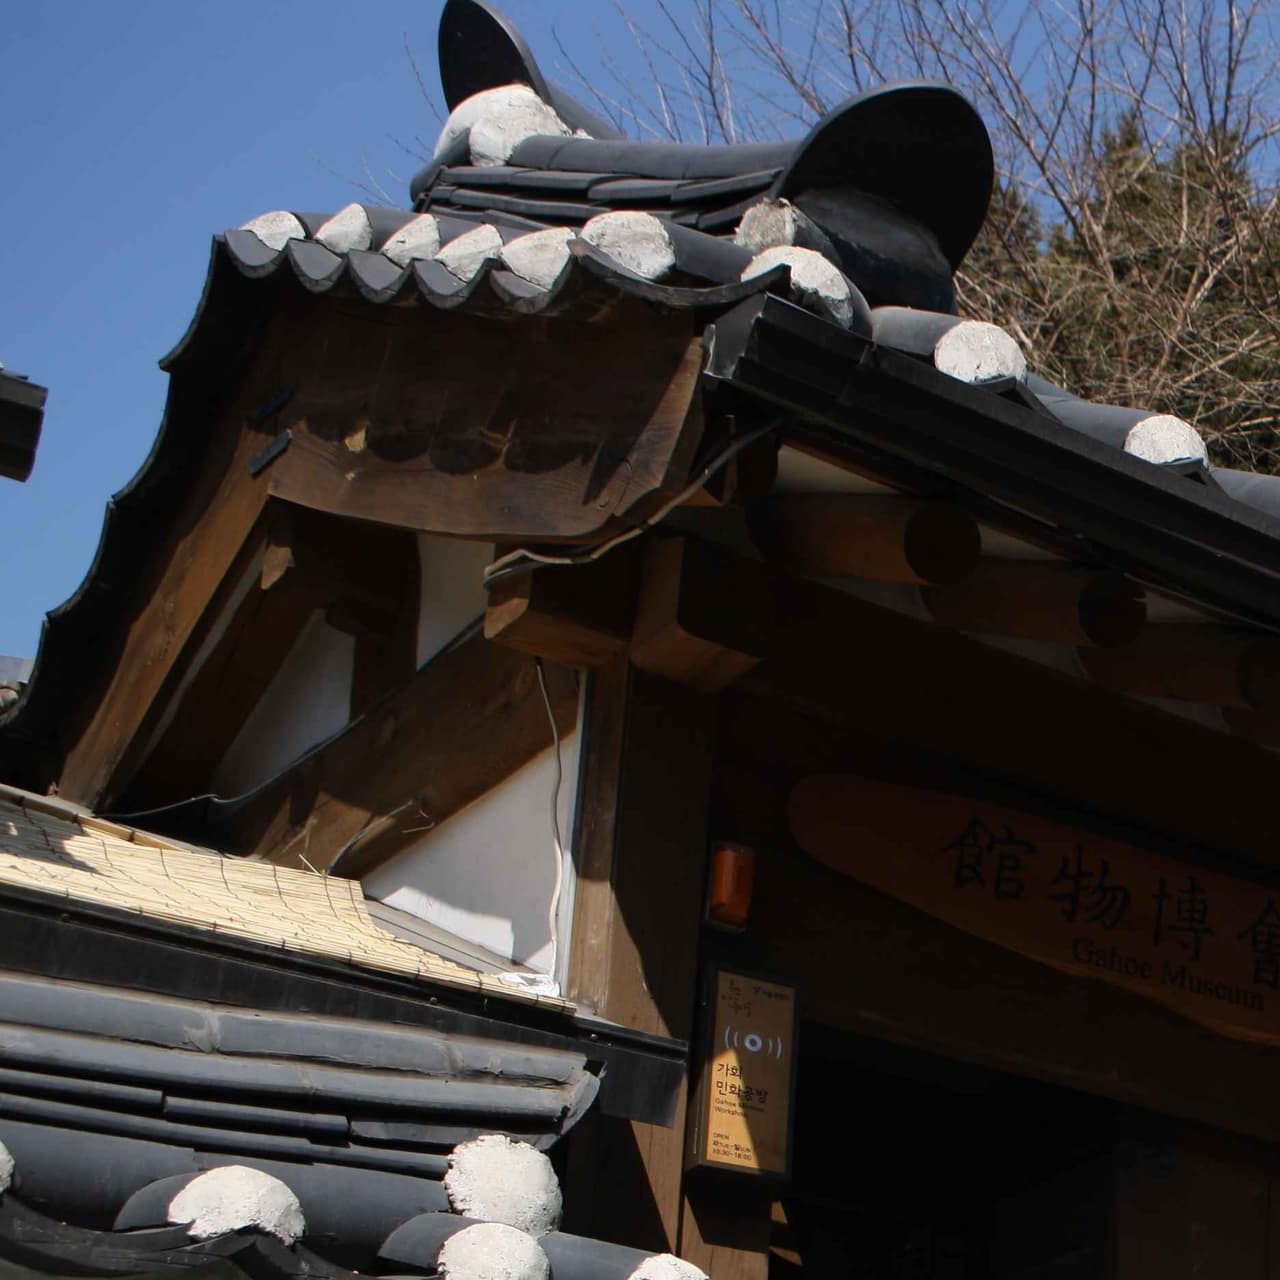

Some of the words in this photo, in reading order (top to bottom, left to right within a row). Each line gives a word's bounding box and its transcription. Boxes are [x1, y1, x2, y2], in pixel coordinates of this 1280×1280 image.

[1071, 937, 1152, 981] Gahoe
[1161, 958, 1265, 1013] Museum
[717, 1063, 743, 1081] 가회
[716, 1081, 768, 1104] 민화공방
